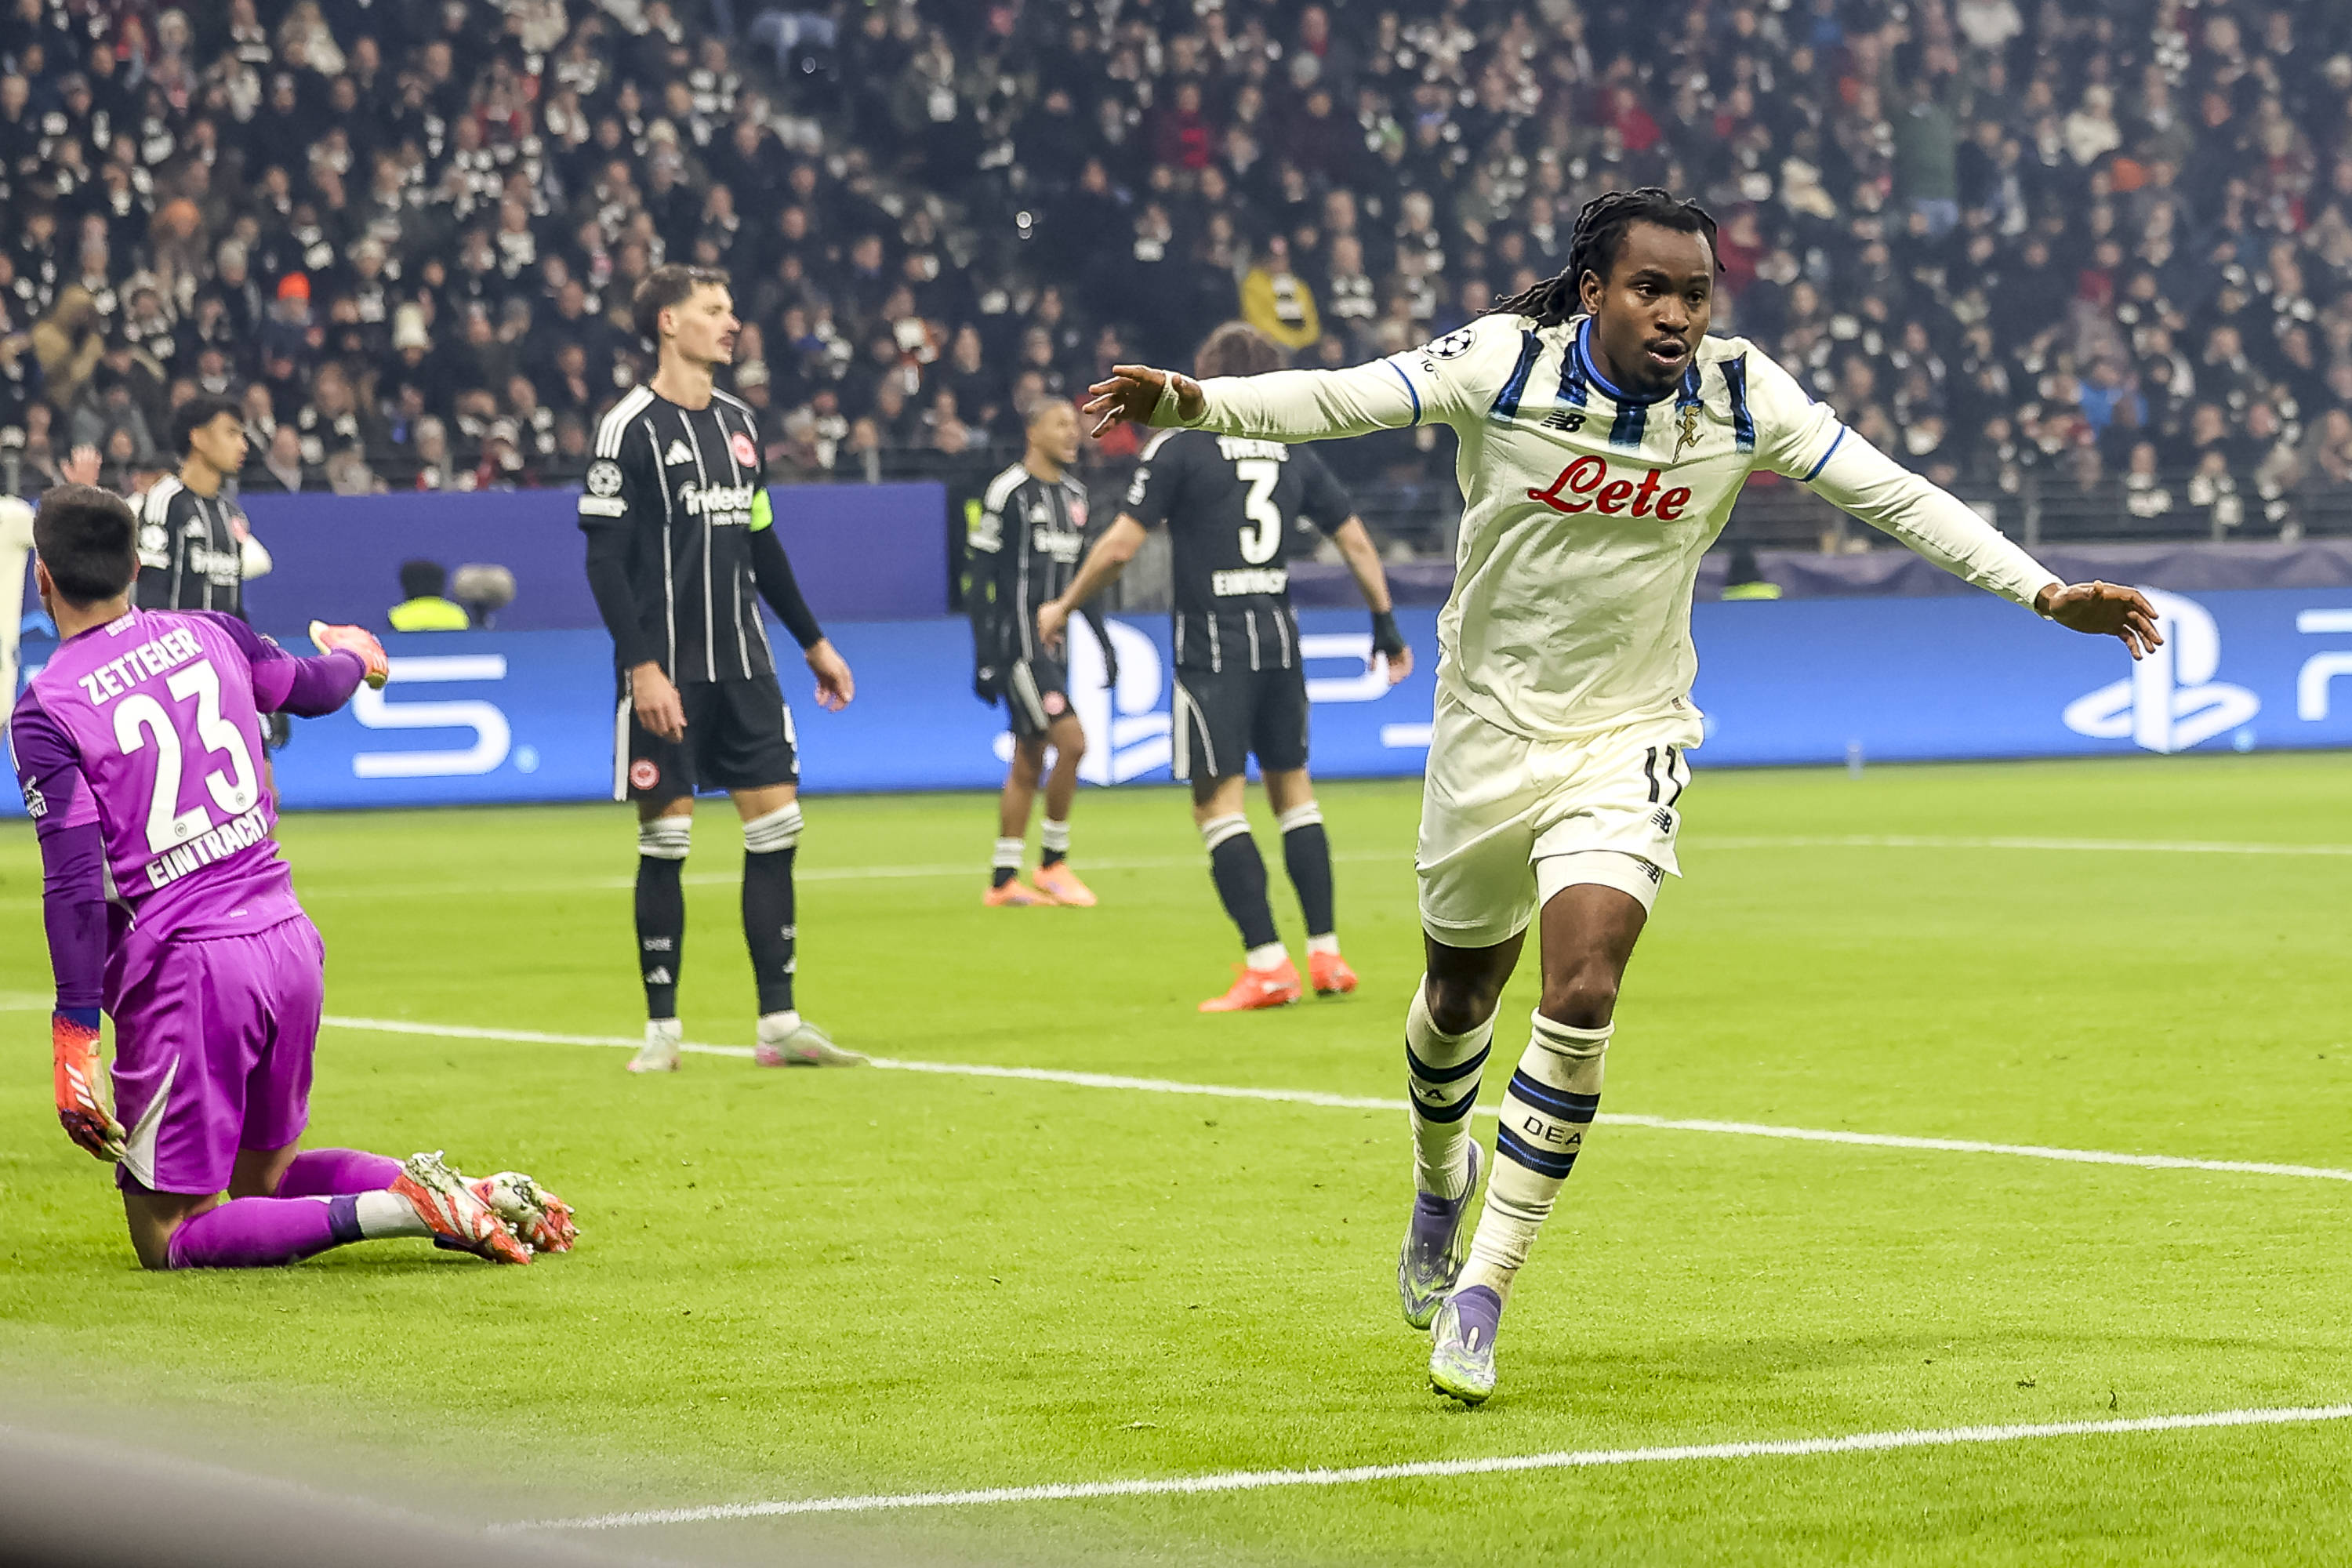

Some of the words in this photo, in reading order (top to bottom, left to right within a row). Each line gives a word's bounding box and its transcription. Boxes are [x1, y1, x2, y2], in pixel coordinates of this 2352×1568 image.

[1236, 459, 1281, 564] 3
[1527, 455, 1692, 521] Lete
[79, 627, 204, 706] ZETTERER
[113, 659, 259, 855] 23
[1644, 744, 1682, 808] 11
[145, 804, 270, 889] EINTRACHT
[1523, 1116, 1581, 1145] DEA
